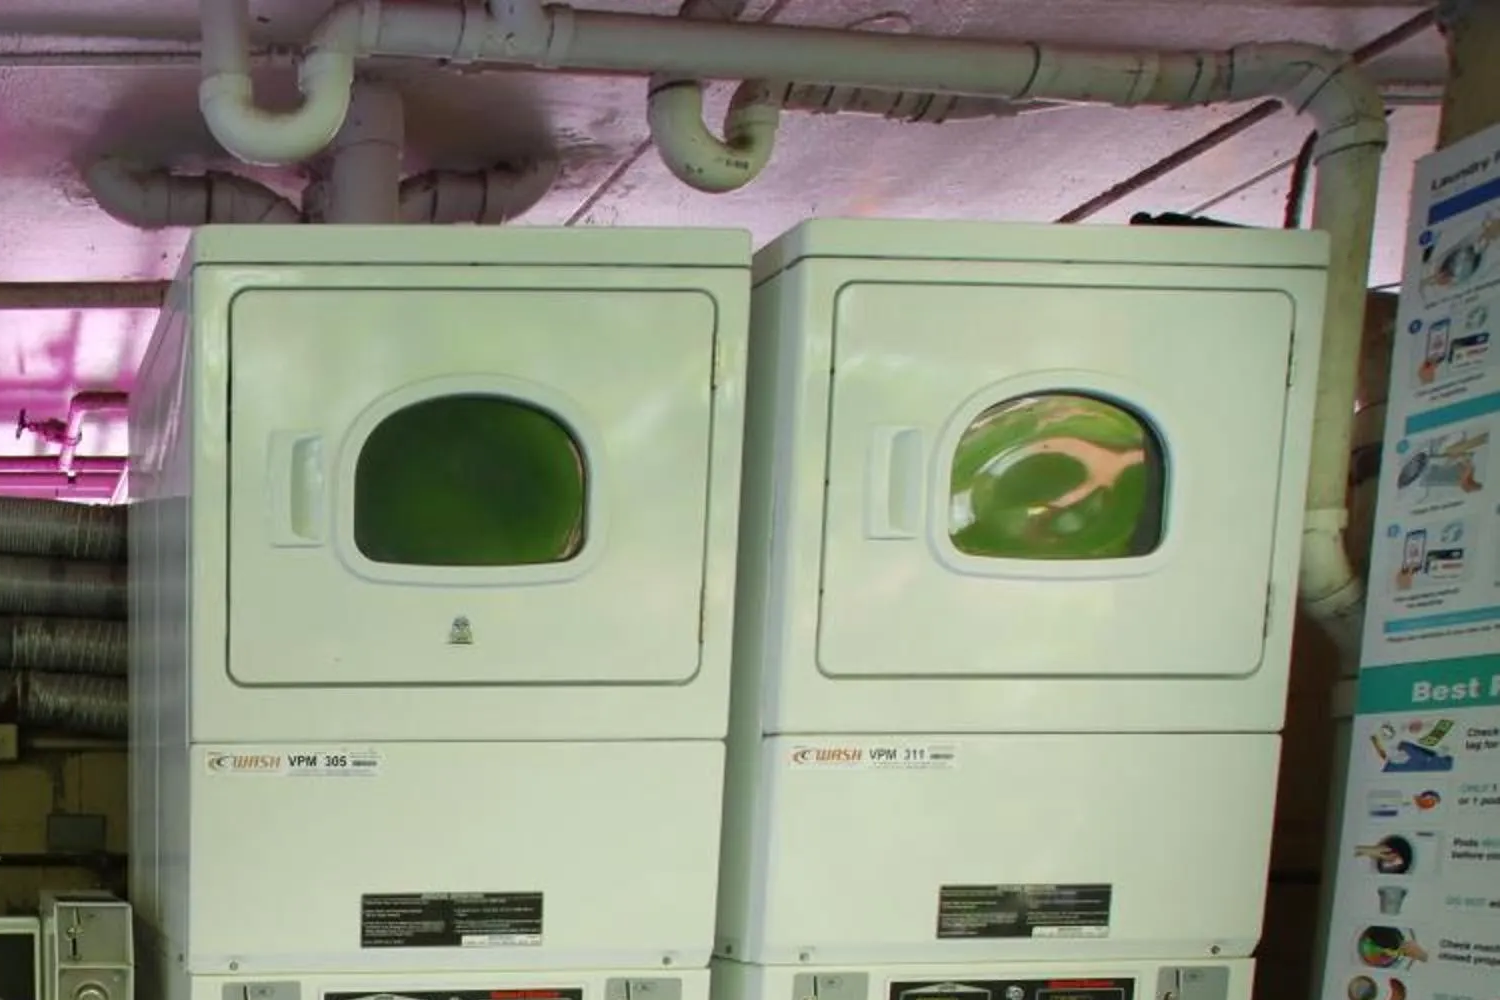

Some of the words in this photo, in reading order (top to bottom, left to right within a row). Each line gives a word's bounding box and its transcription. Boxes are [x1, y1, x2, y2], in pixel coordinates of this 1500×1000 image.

[1411, 677, 1482, 703] Best
[869, 748, 897, 760] VPM
[288, 755, 317, 767] VPM
